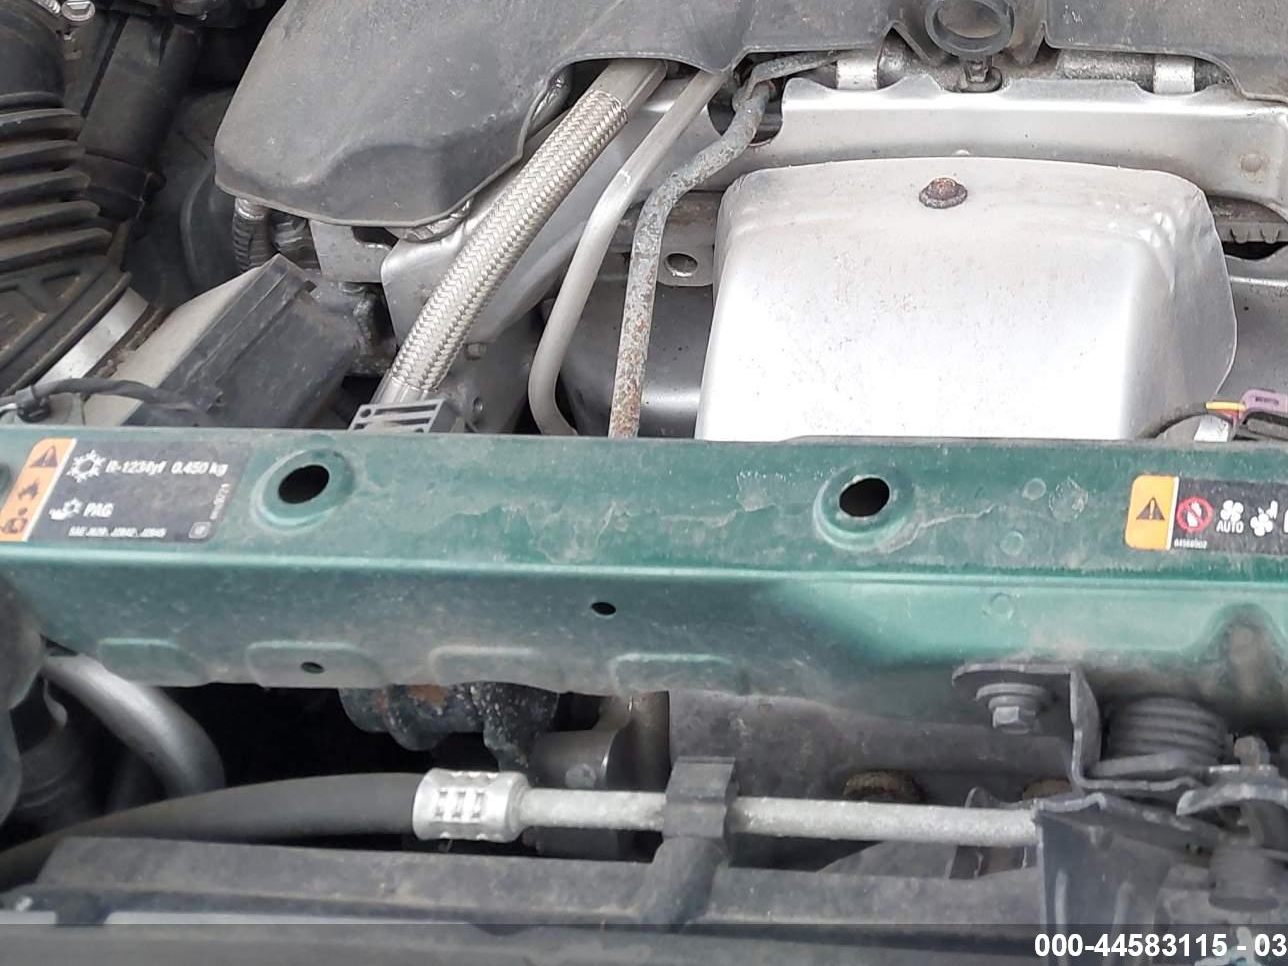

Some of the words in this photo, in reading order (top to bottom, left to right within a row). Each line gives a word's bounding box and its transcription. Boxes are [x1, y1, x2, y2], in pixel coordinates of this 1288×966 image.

[105, 460, 168, 476] R-1234yf
[171, 460, 208, 474] 0.450
[209, 461, 229, 478] kg
[1216, 522, 1244, 534] AUTO
